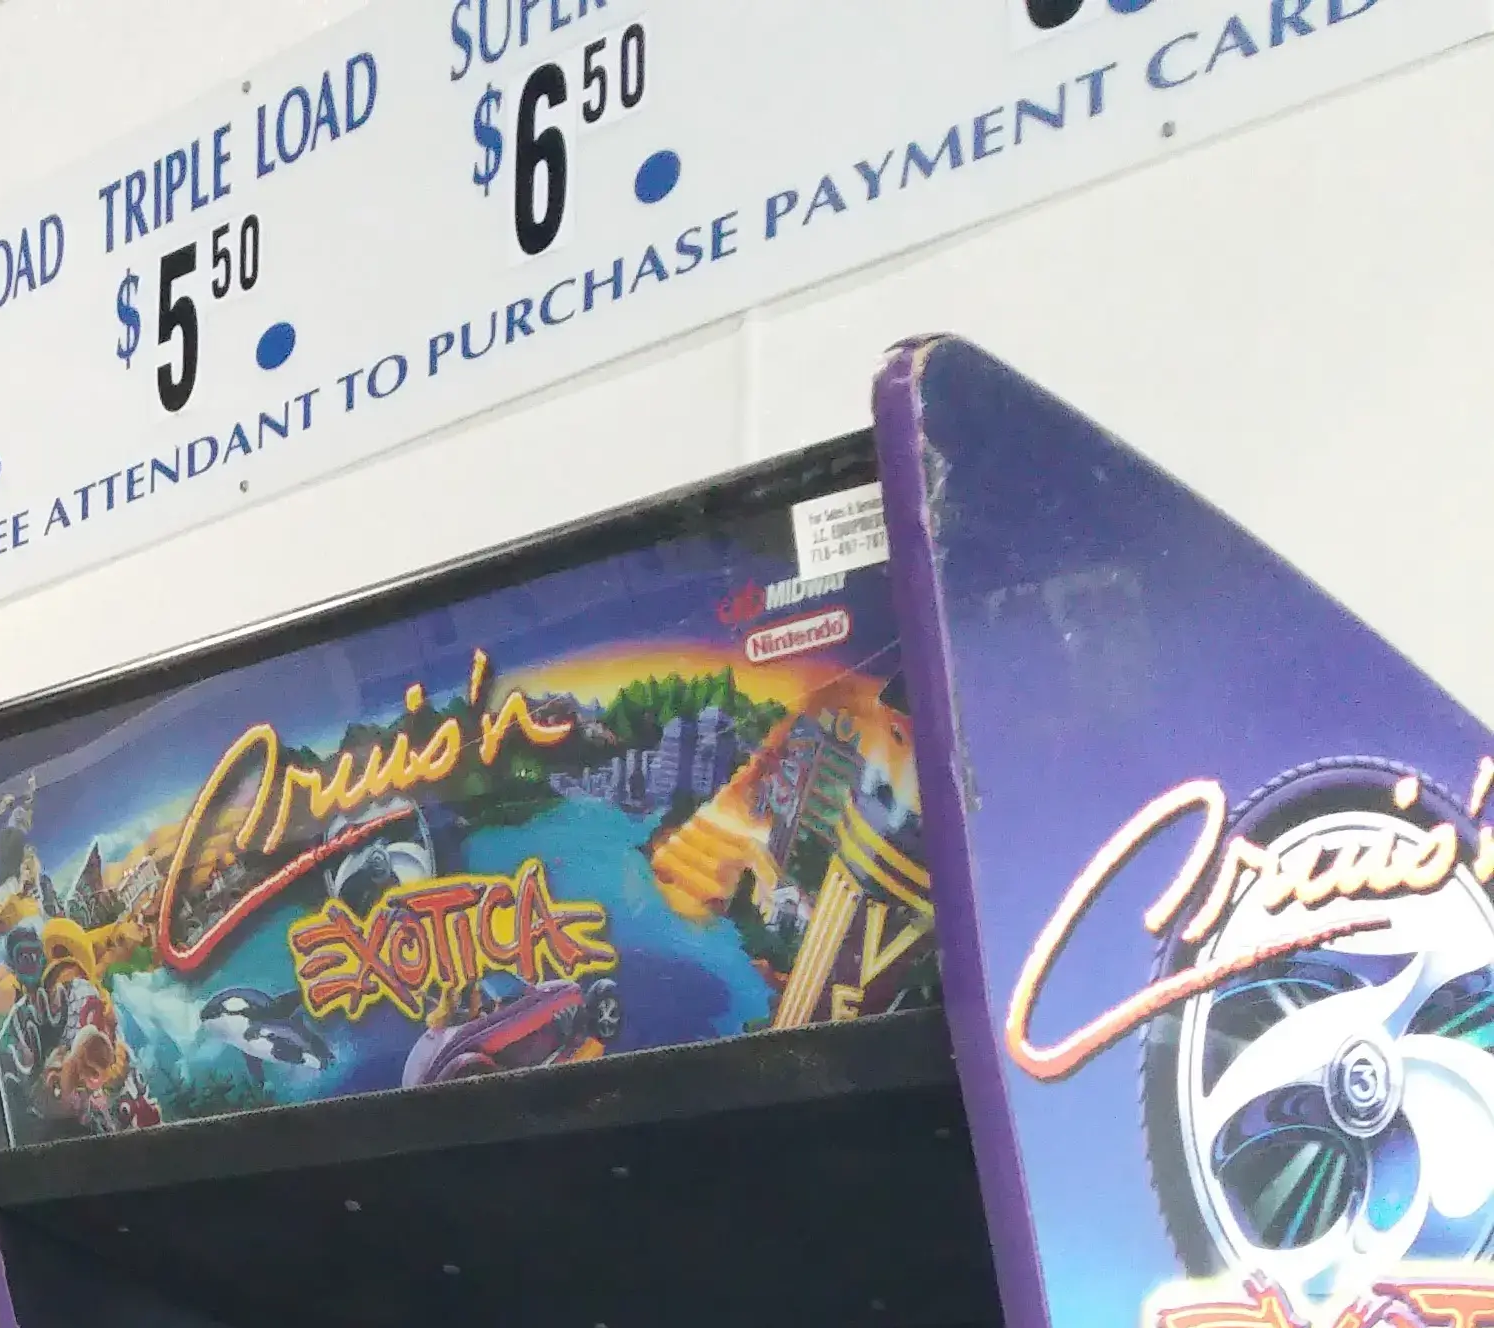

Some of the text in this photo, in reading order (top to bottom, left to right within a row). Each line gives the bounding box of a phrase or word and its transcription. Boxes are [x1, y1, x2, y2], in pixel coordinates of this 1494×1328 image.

[98, 51, 378, 254] TRIPLE LOAD
[43, 393, 317, 533] ATTENDANT
[339, 353, 408, 412] TO
[427, 211, 739, 378] PURCHASE
[763, 62, 1119, 240] PAYMENT
[751, 614, 845, 657] Nintendo
[157, 648, 573, 972] Cruis'n
[288, 858, 619, 1022] EXOTICA
